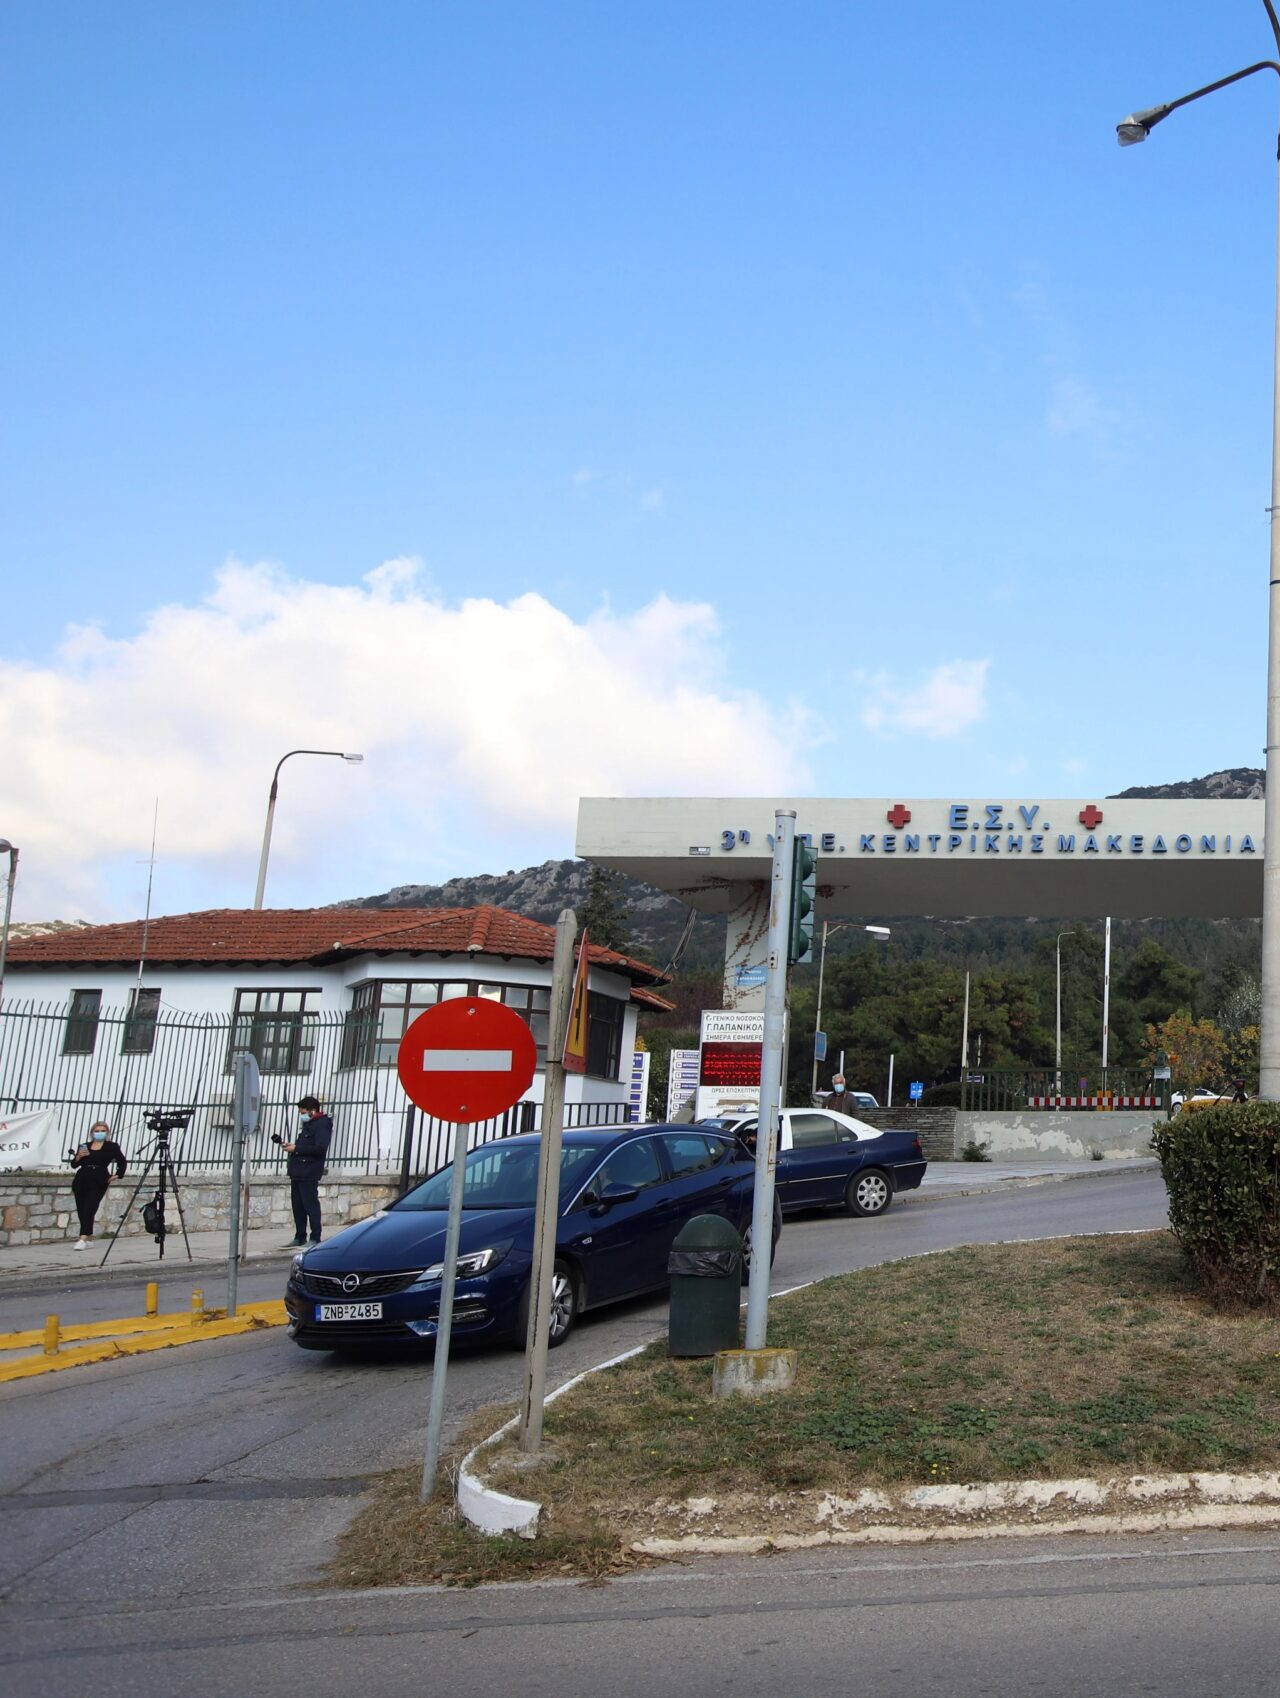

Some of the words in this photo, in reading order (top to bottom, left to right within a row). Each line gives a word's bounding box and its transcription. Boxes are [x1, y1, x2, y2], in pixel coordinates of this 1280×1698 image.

[950, 804, 1050, 829] Ε.Σ.Υ.
[721, 830, 750, 850] 3η
[860, 834, 1044, 852] ΚΕΝΤΡΙΚΗΣ
[1057, 834, 1265, 852] ΜΑΚΕΔΟΝΙΑ
[324, 1304, 380, 1319] ZNB-2485
